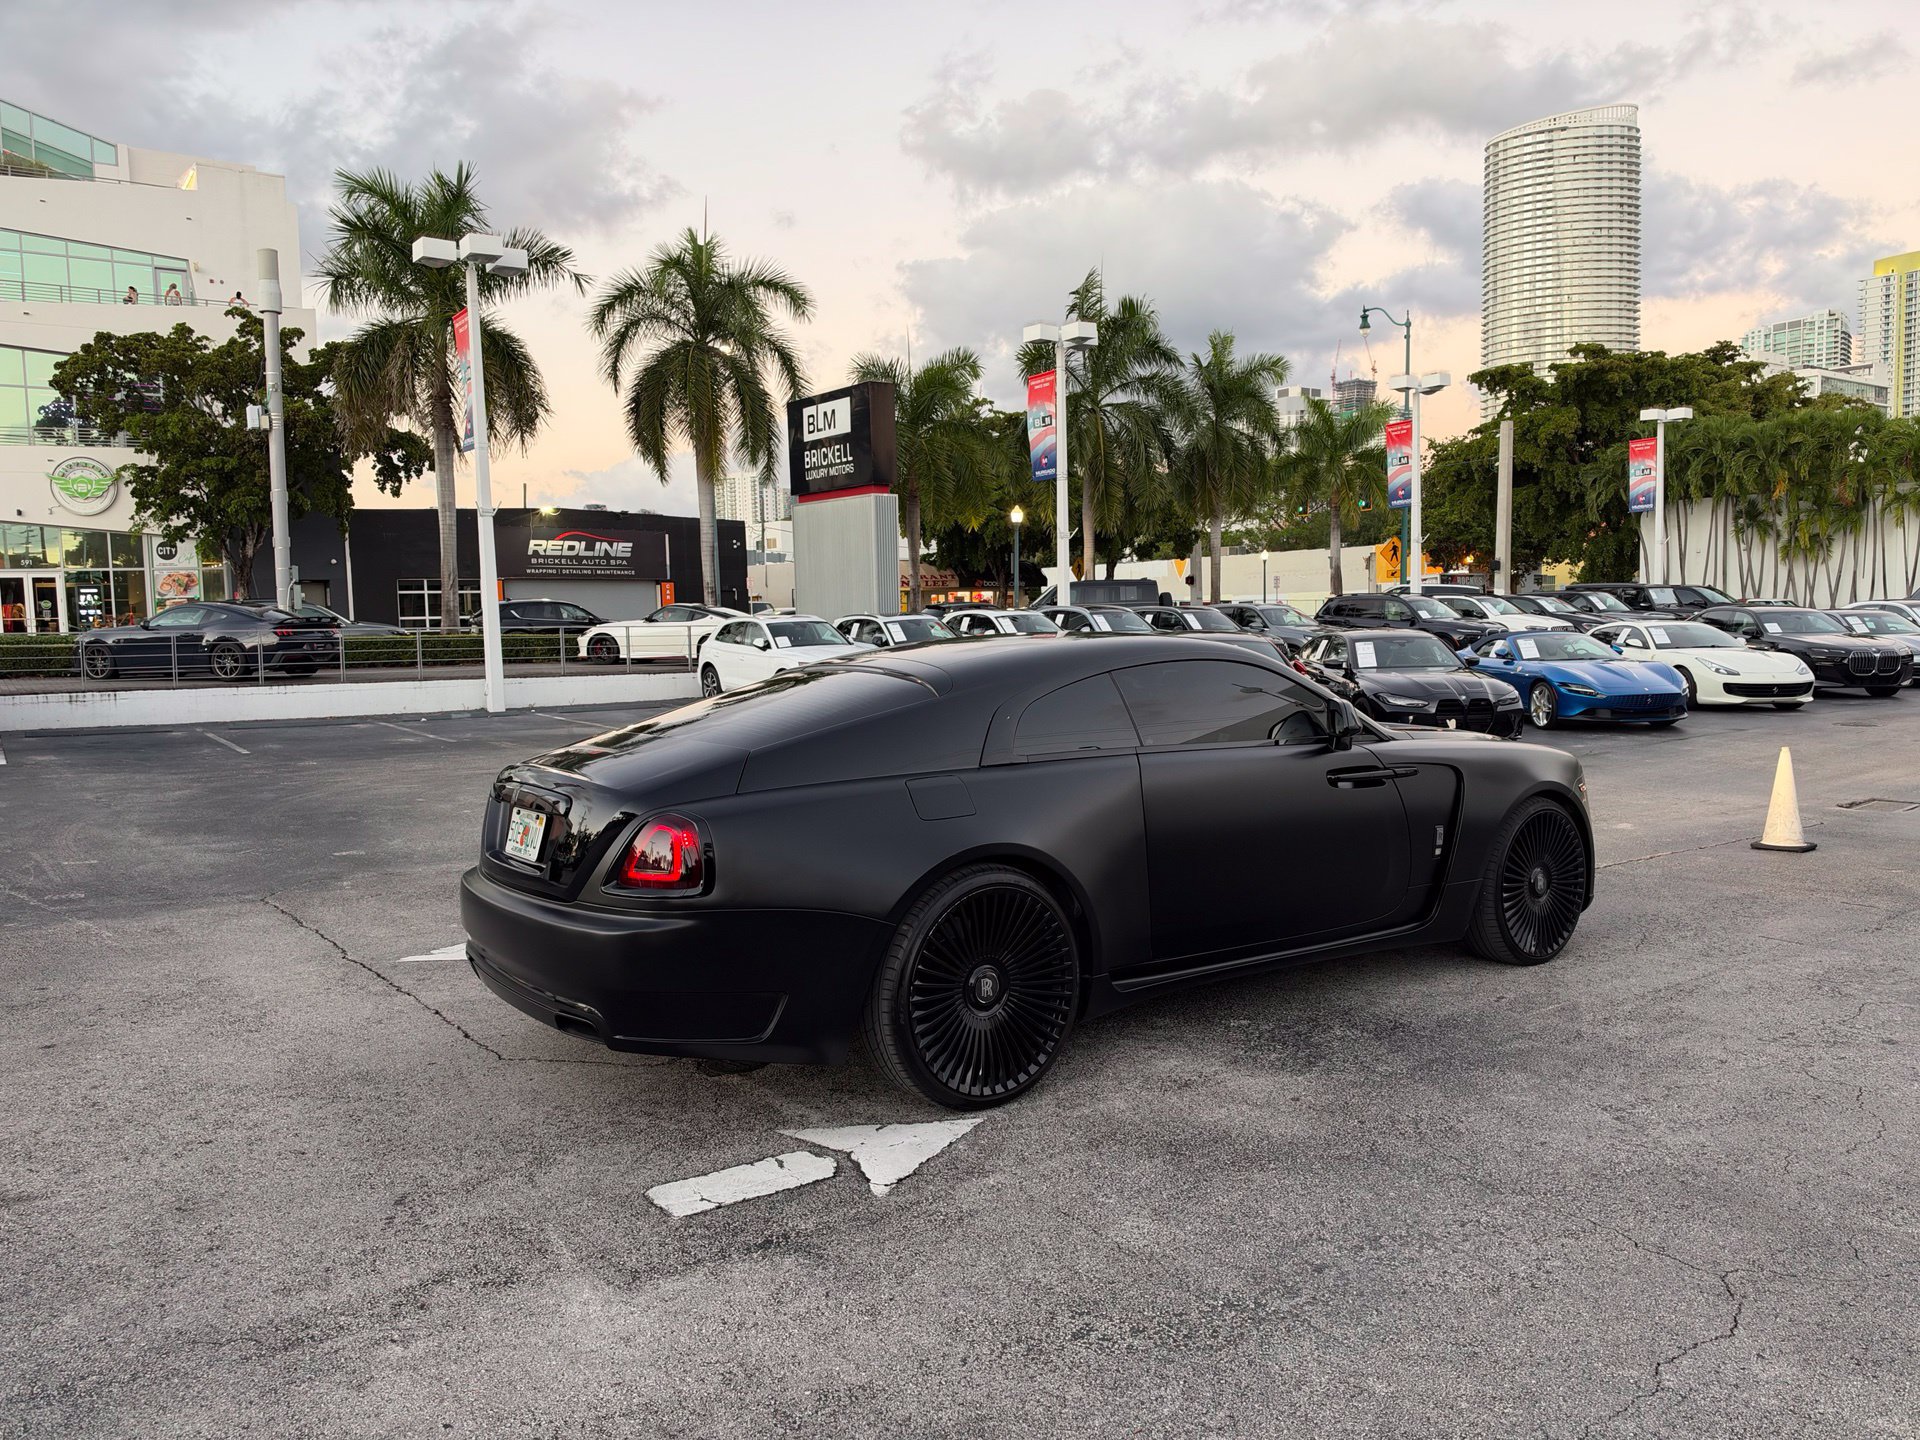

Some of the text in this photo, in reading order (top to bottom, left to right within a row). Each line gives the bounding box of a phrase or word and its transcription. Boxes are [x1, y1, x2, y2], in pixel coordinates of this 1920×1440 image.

[807, 405, 836, 435] BLM
[804, 443, 854, 469] BRICKELL
[805, 463, 855, 481] LUXURY MOTORS
[157, 546, 176, 555] CITY
[527, 540, 633, 558] REDLINE
